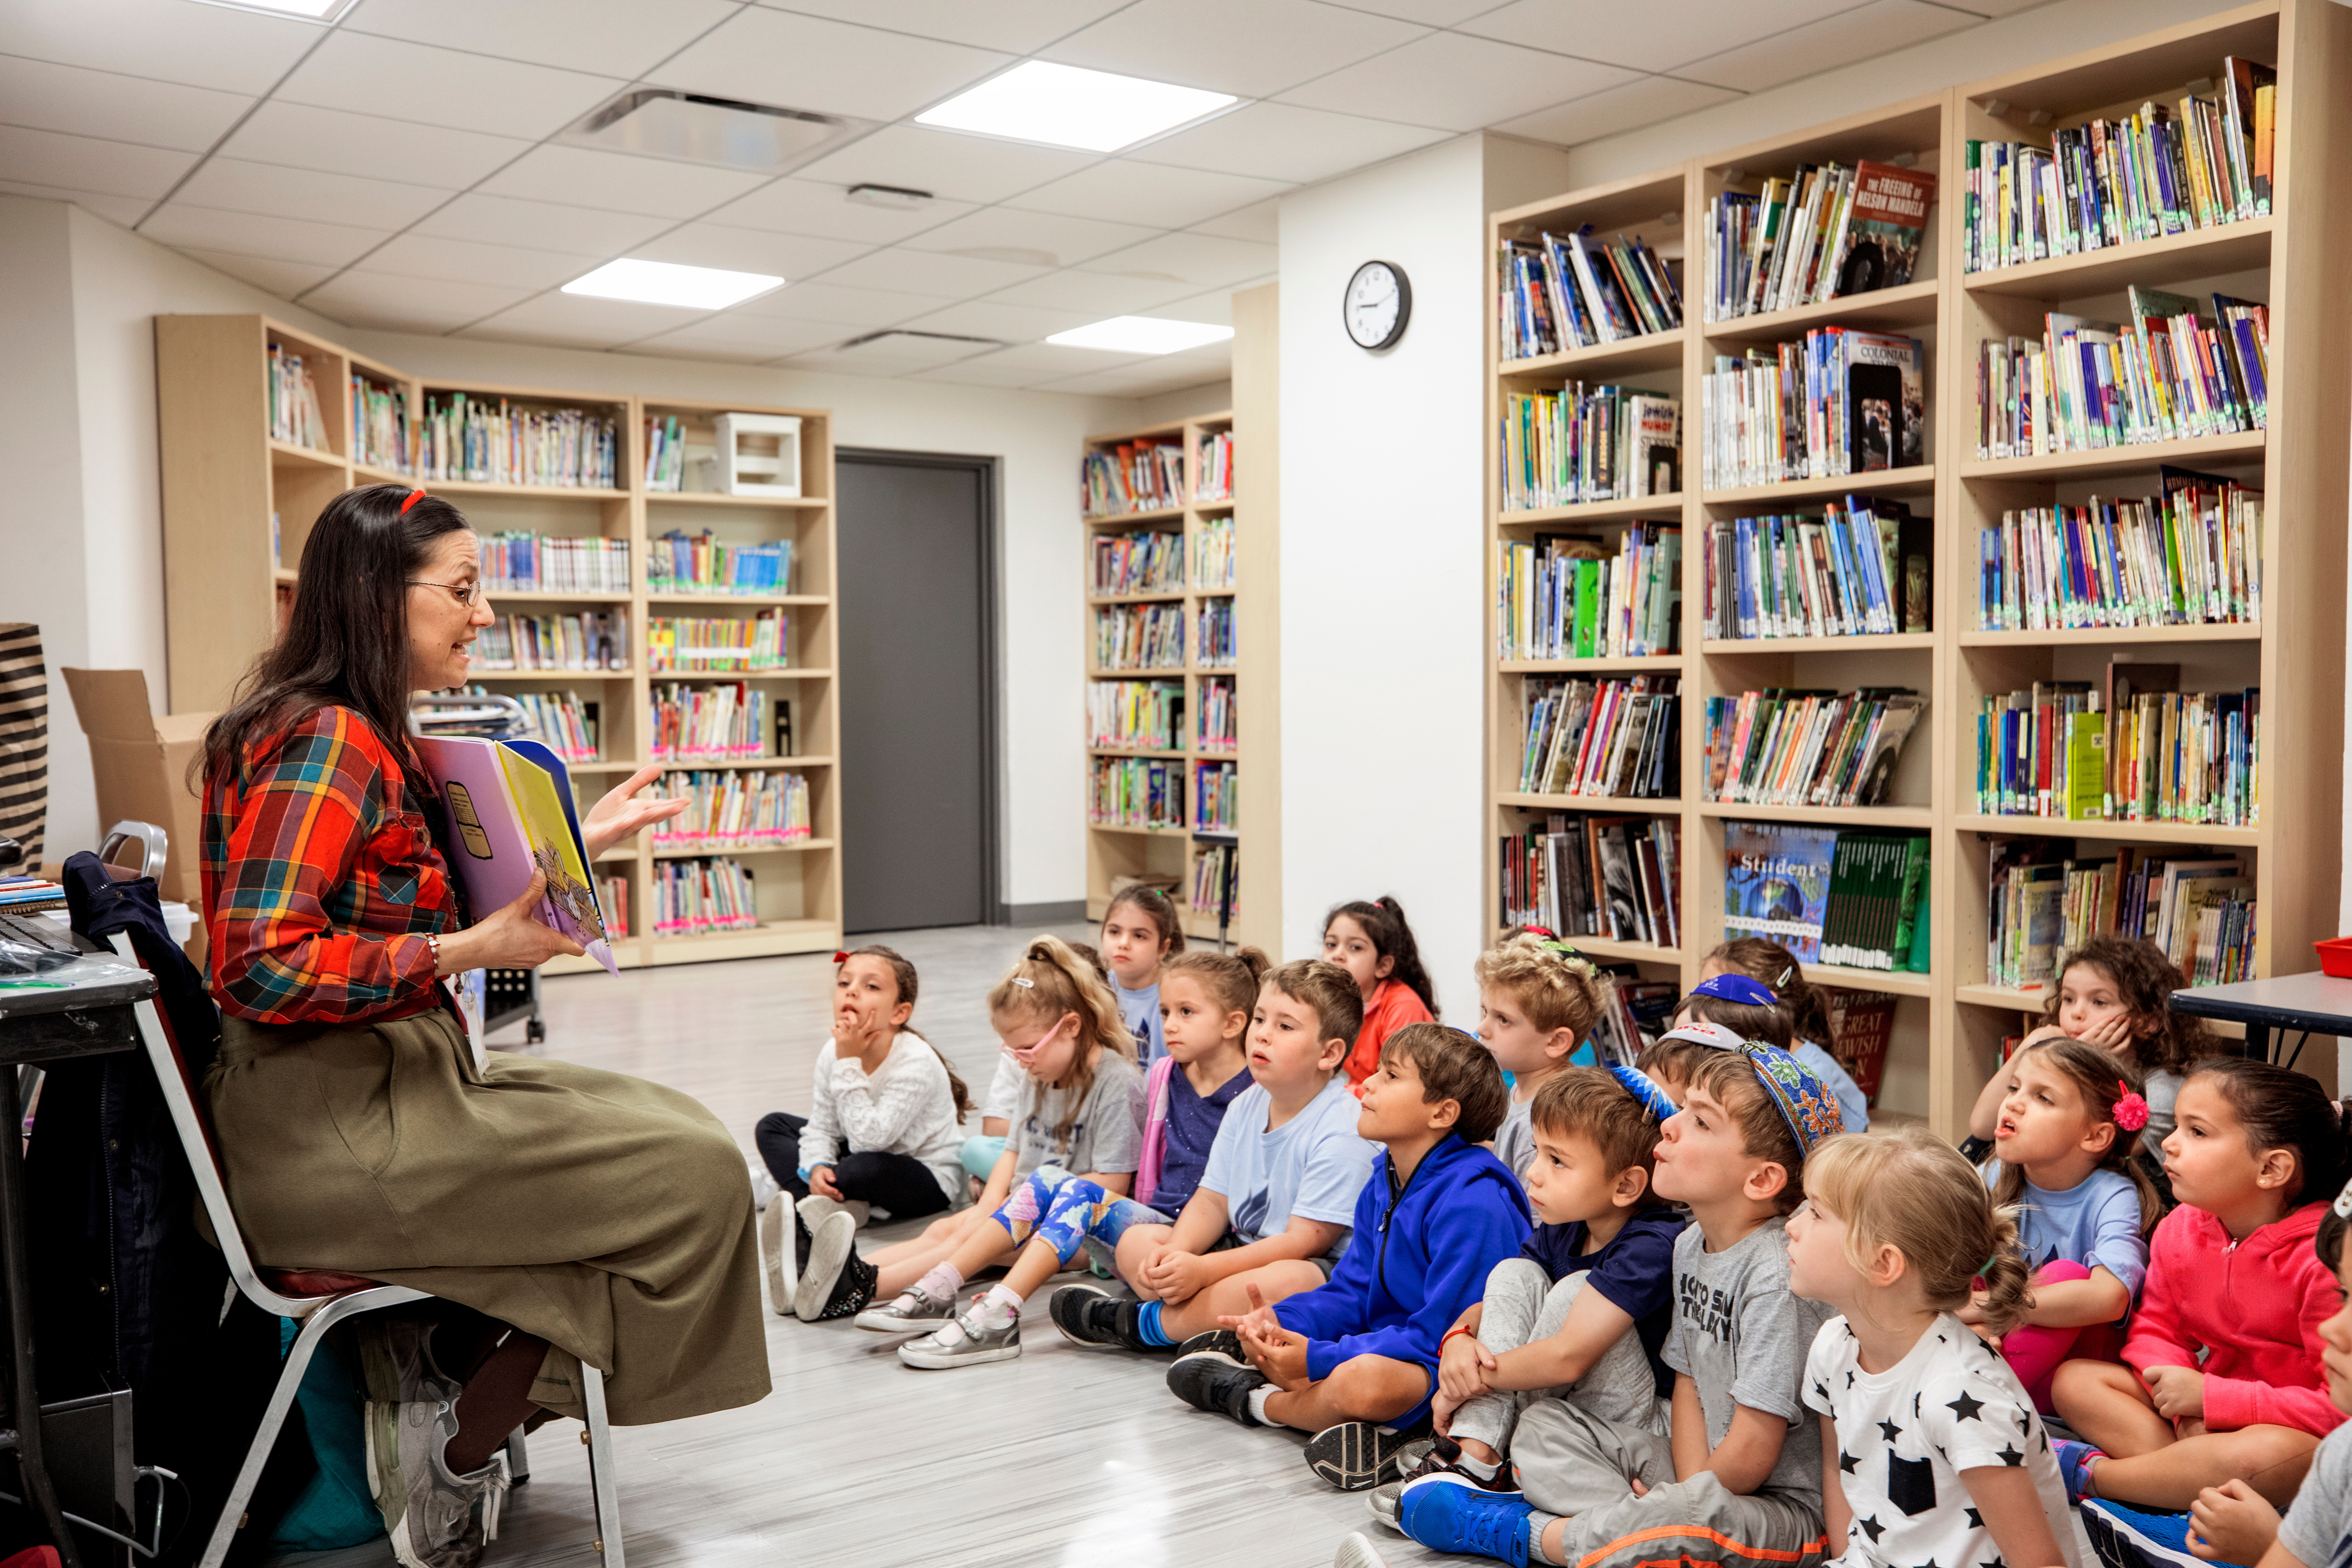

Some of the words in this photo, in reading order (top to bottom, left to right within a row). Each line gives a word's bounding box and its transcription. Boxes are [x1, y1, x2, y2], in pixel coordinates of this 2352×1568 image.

[1867, 178, 1880, 192] THE
[1879, 176, 1914, 198] FREEING
[1913, 186, 1923, 200] OF
[1856, 190, 1888, 211] NELSON
[1887, 196, 1925, 217] MANDELA
[1861, 346, 1910, 363] COLONIAL
[1599, 430, 1608, 469] HOCKEY
[1741, 854, 1816, 878] Student
